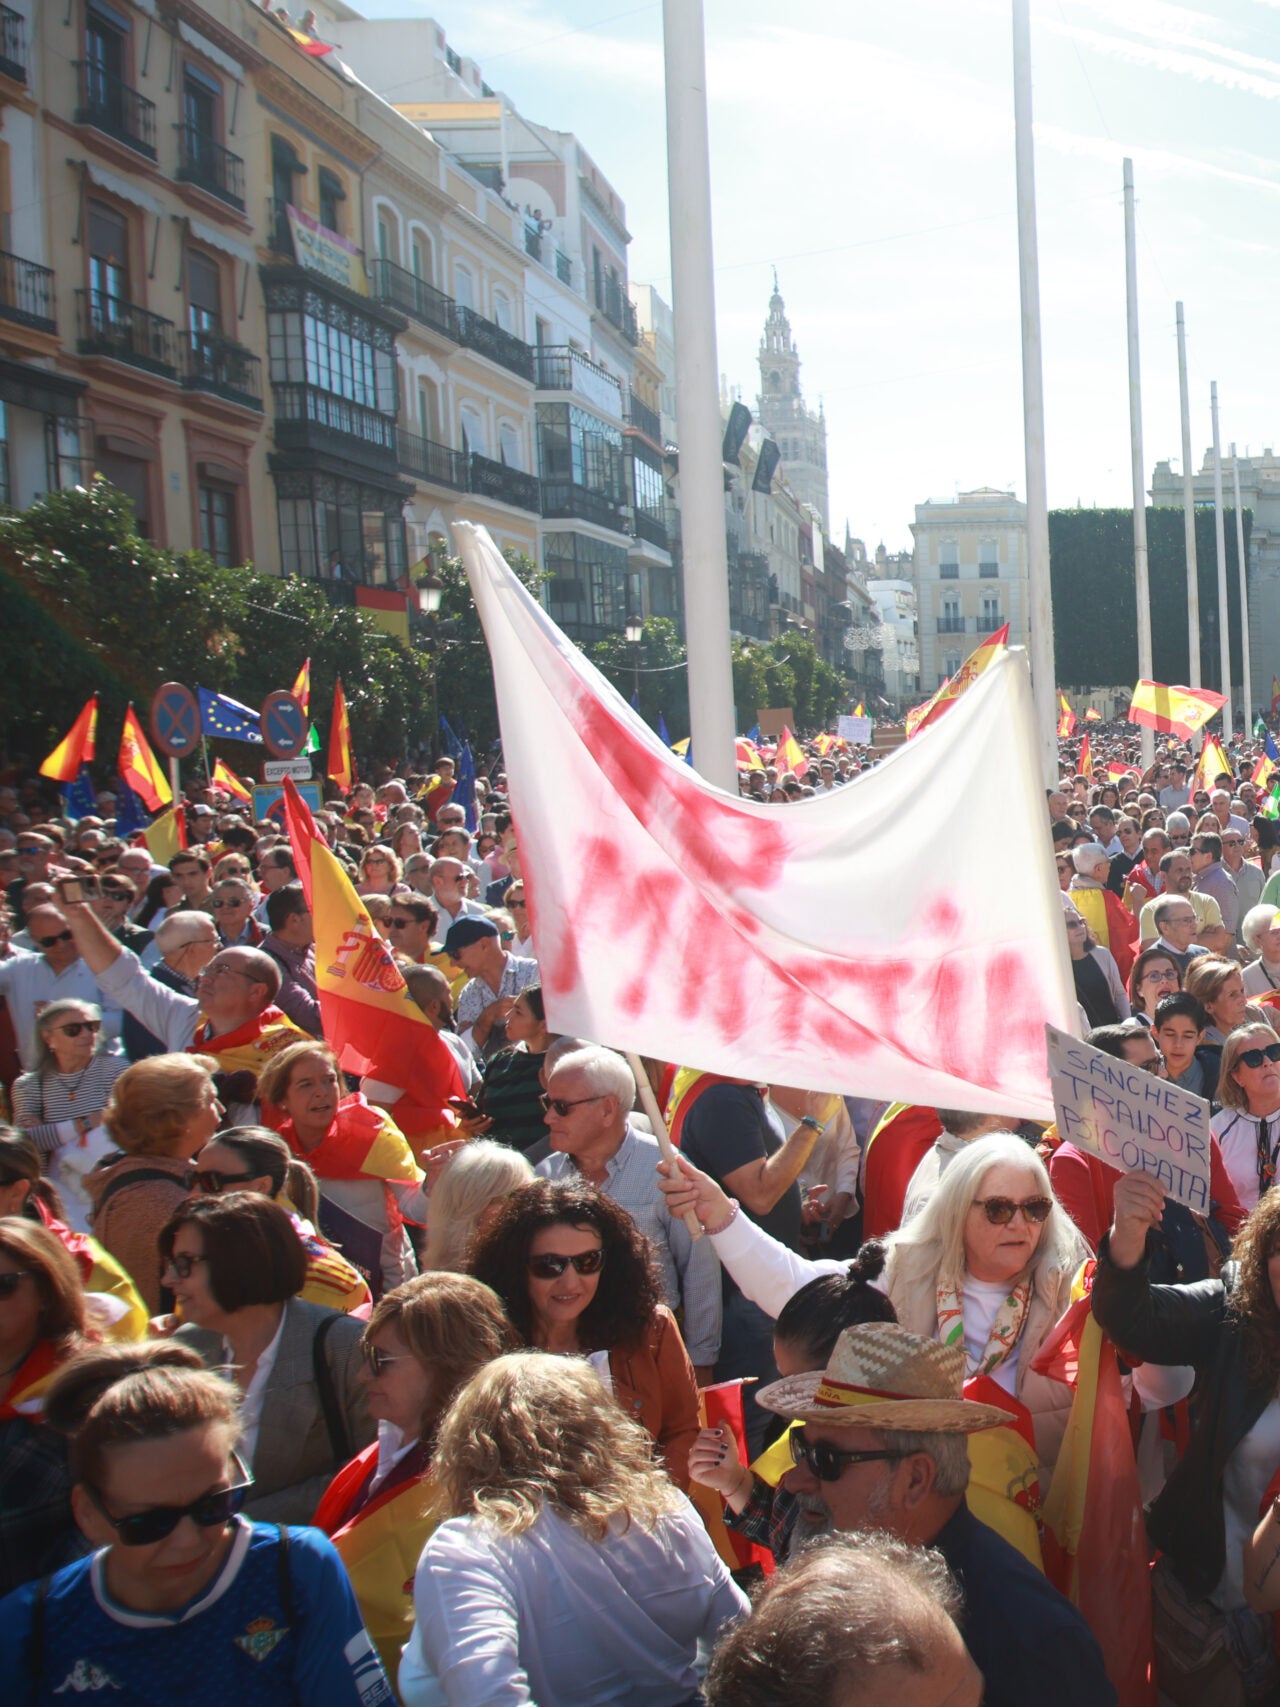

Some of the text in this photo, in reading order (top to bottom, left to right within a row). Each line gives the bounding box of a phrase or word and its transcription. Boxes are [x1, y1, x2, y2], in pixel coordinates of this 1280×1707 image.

[1060, 1070, 1207, 1166] TRAIDOR
[1067, 1050, 1204, 1129] SÁNCHEZ
[1060, 1104, 1208, 1208] PSICÓPATA
